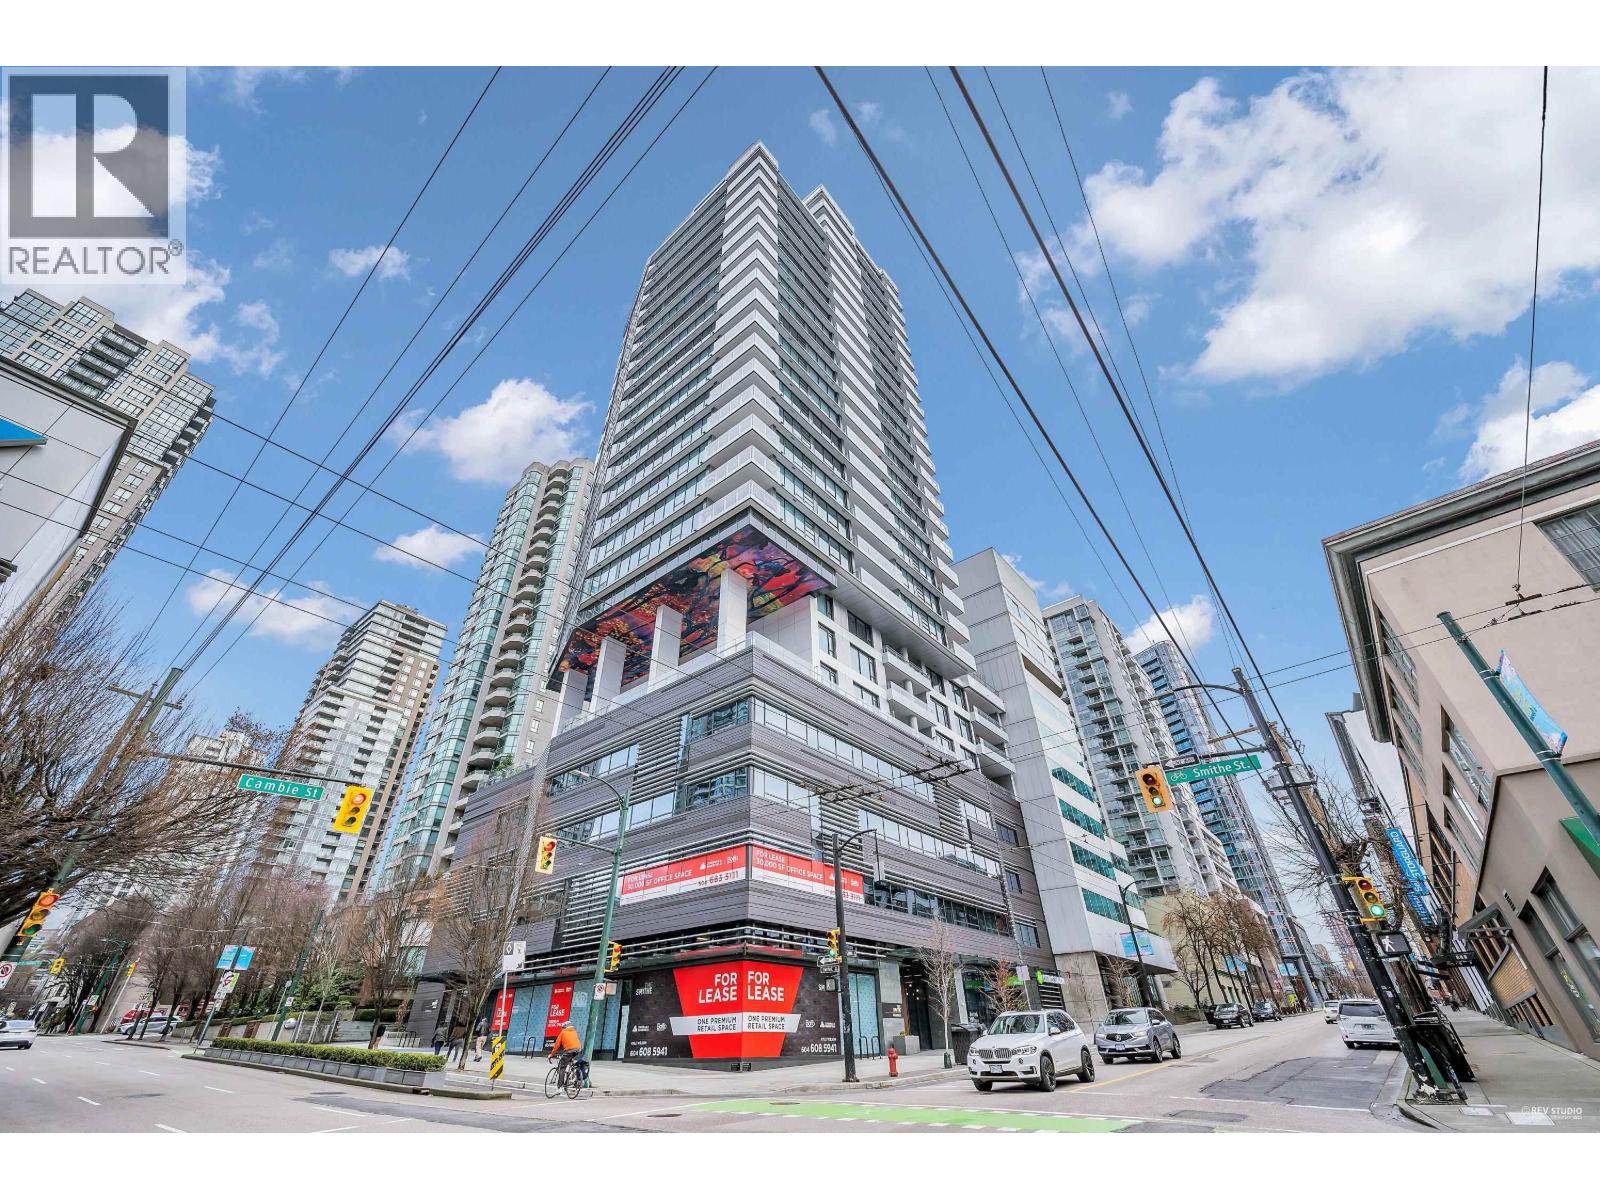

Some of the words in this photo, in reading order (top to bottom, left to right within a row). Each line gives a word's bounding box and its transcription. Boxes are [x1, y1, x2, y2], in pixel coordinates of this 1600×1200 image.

[1192, 765, 1232, 778] Smithe
[1233, 760, 1251, 769] St.
[245, 778, 299, 795] Cambie
[305, 787, 318, 798] St
[756, 850, 768, 859] FOR
[768, 853, 785, 863] LEASE
[654, 874, 673, 885] OFFICE
[674, 869, 692, 880] SPACE
[778, 863, 786, 871] SF
[786, 866, 806, 876] OFFICE
[806, 870, 824, 880] SPACE
[714, 972, 737, 987] FOR
[747, 971, 770, 985] FOR
[698, 986, 738, 1004] LEASE
[747, 985, 785, 1002] LEASE
[549, 1009, 566, 1017] LEASE
[761, 1015, 785, 1023] PREMIUM
[697, 1017, 709, 1025] ONE
[710, 1016, 737, 1025] PREMIUM
[768, 1022, 785, 1030] SPACE
[639, 1046, 652, 1057] 608
[652, 1046, 668, 1057] 5941
[810, 1043, 823, 1053] 608
[823, 1043, 837, 1053] 5941
